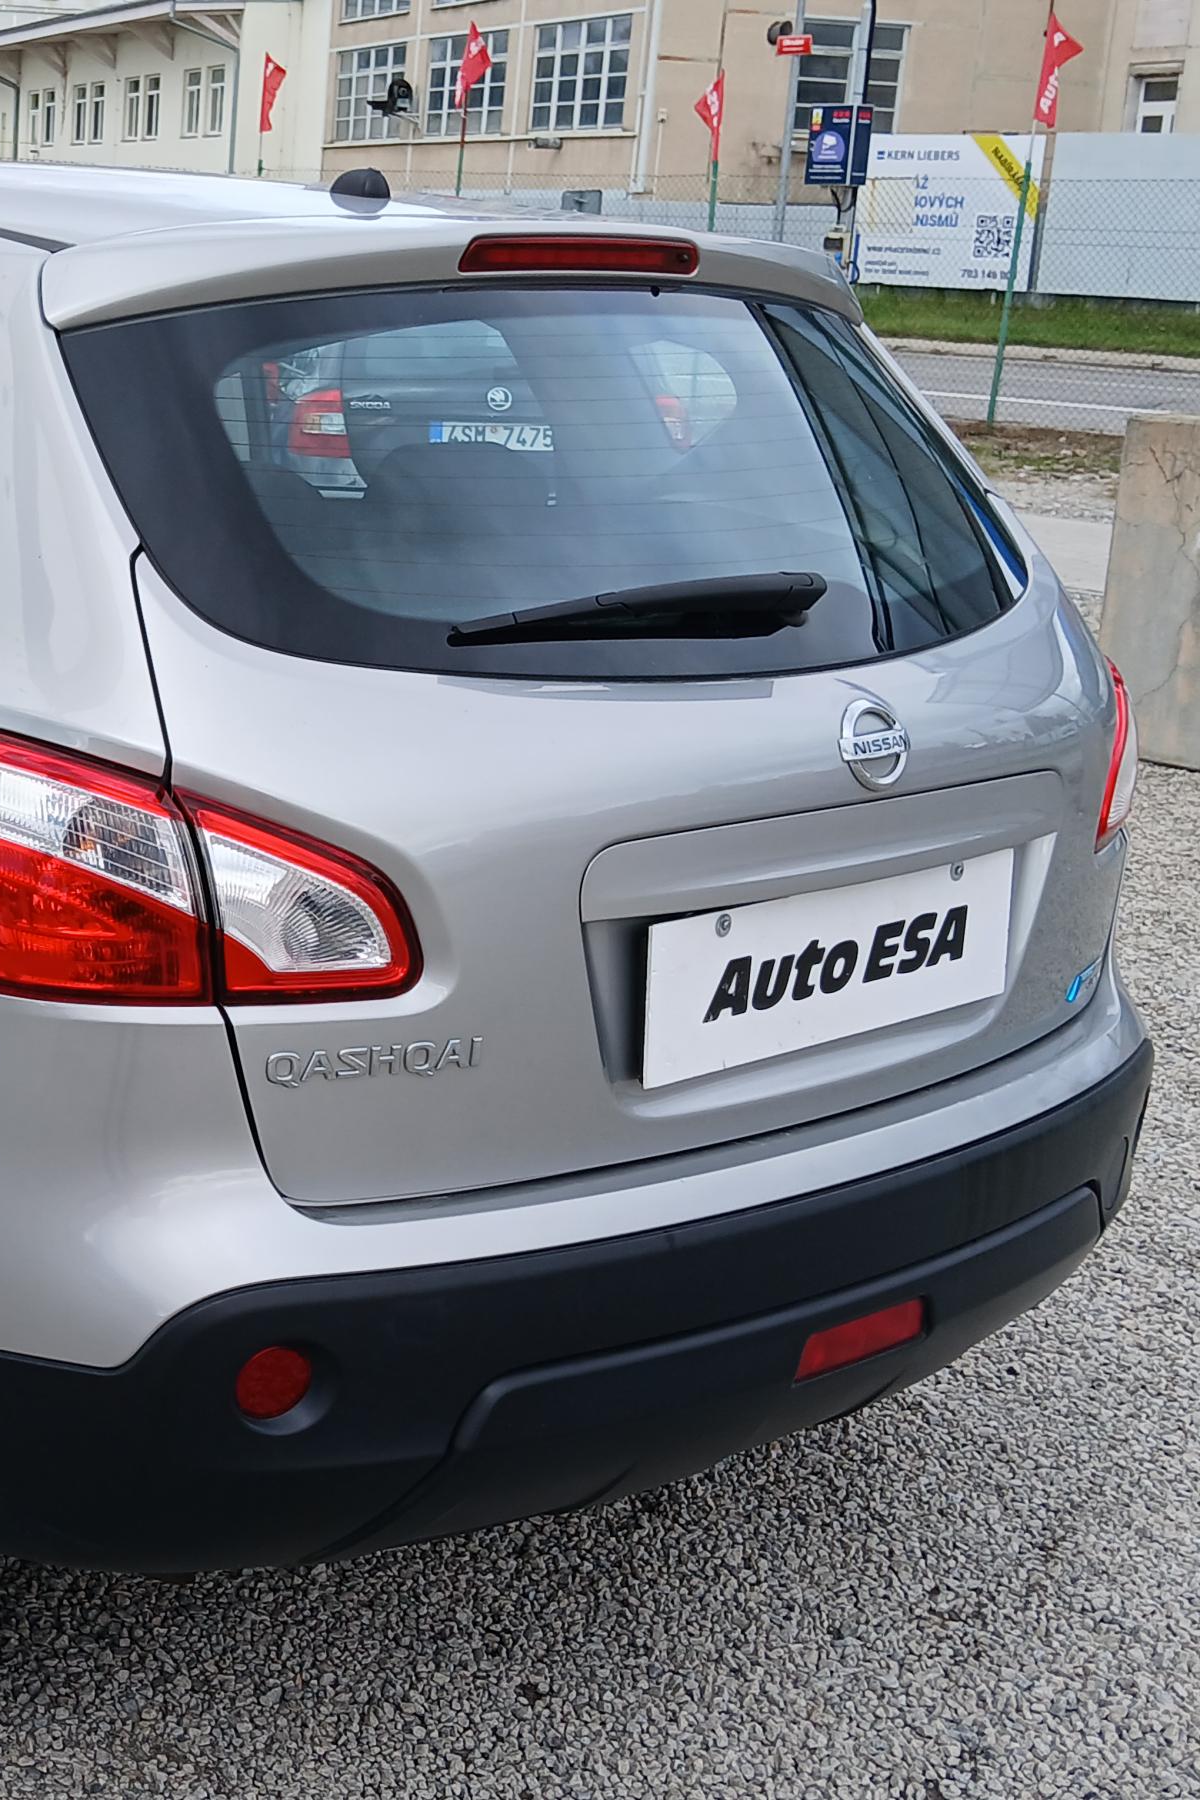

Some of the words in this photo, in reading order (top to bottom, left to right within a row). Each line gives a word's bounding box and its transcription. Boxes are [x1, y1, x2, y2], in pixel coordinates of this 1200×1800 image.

[887, 150, 915, 160] KERN
[917, 150, 960, 161] LIEBERS
[913, 211, 959, 227] NISMŮ
[853, 735, 906, 755] NISSAN
[702, 939, 859, 1023] Auto
[862, 904, 968, 984] ESA
[265, 1036, 483, 1088] QASHQAI
